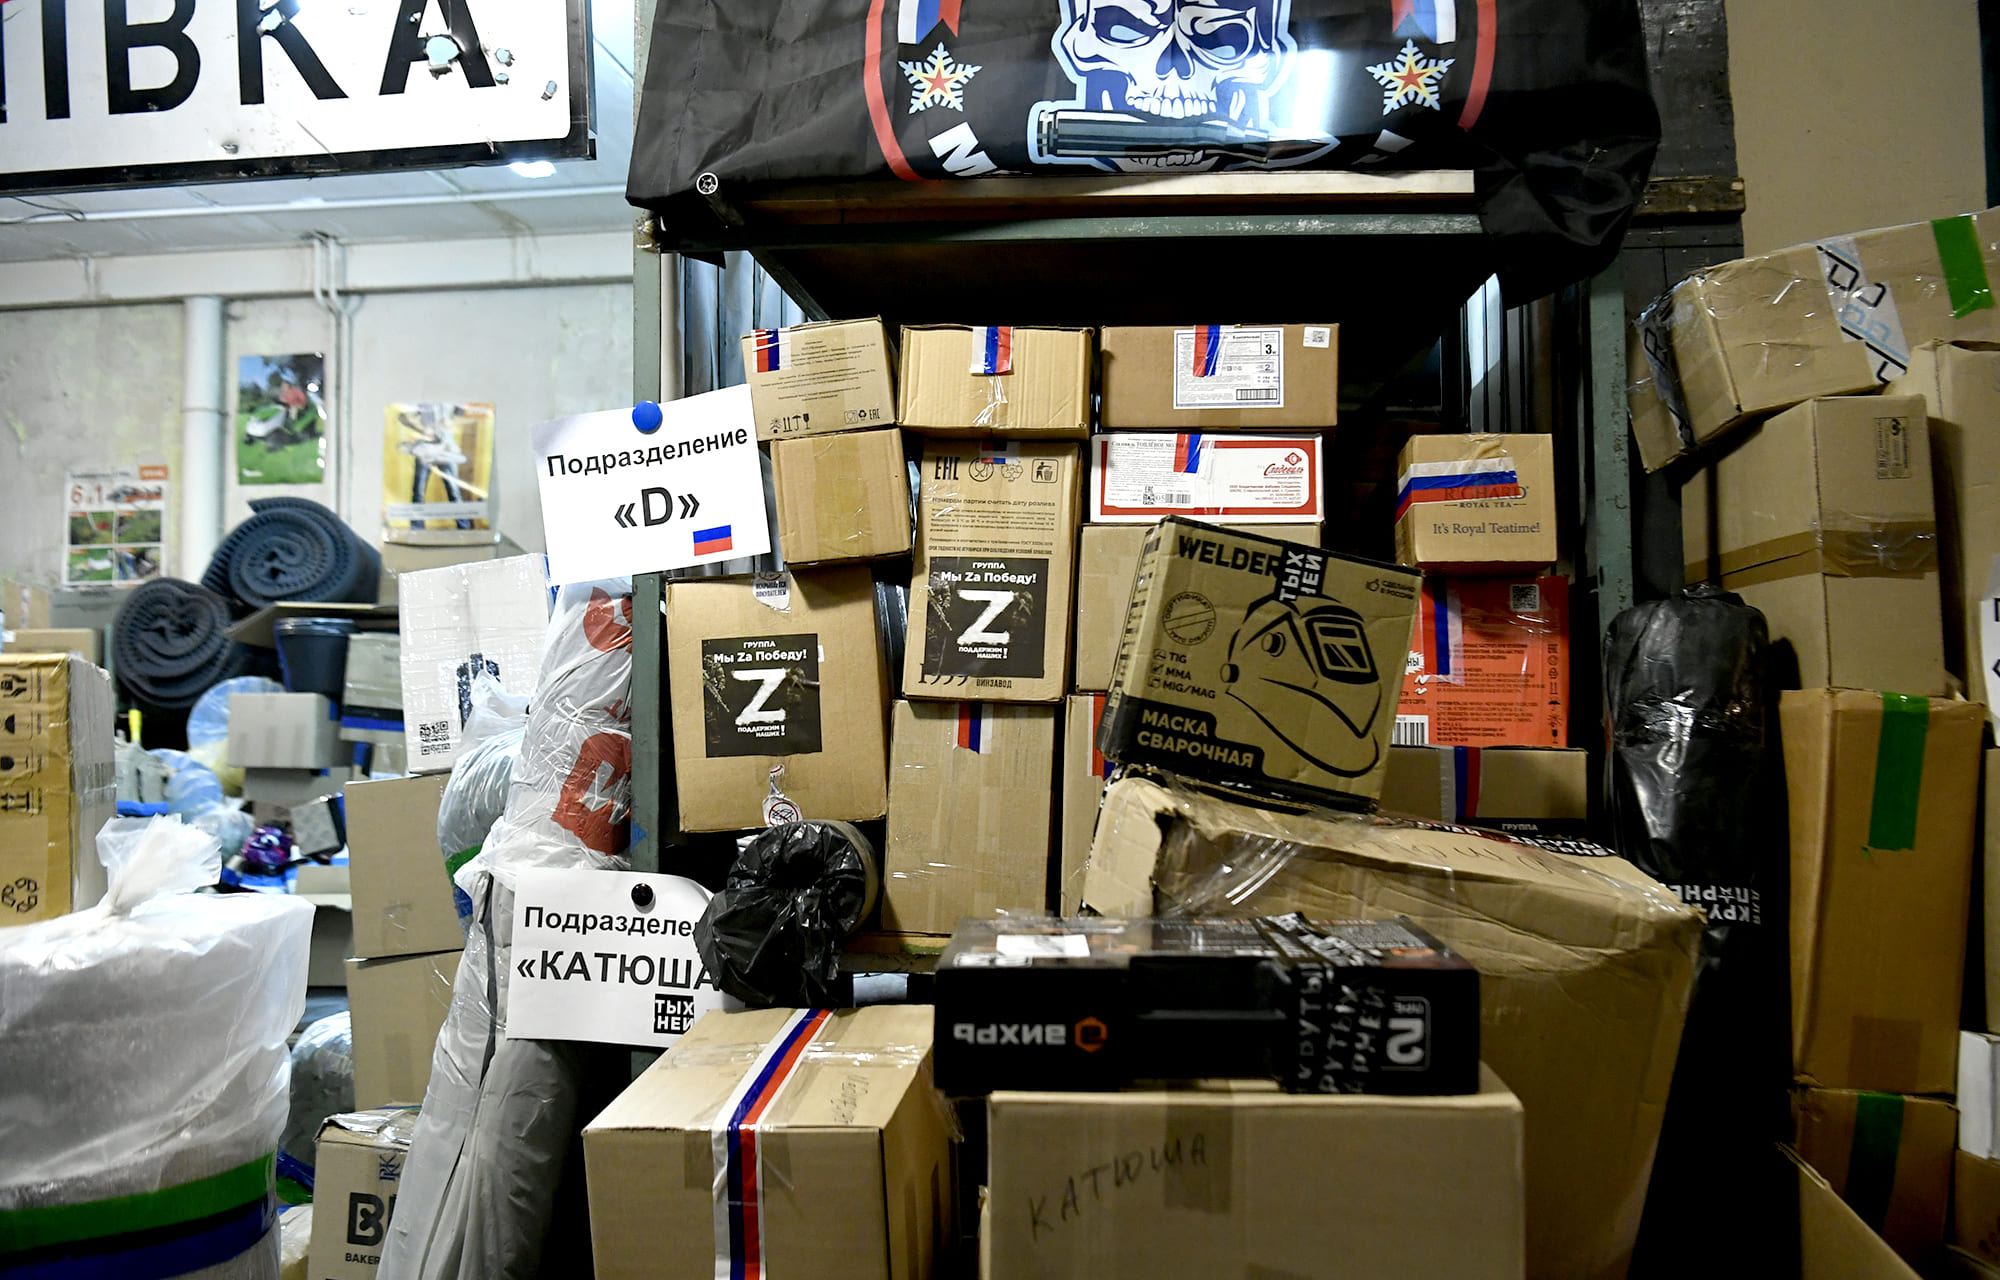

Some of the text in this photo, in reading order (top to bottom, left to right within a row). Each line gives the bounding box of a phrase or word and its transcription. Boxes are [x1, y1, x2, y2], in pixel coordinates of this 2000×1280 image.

[547, 428, 748, 477] Подразделение
[614, 486, 701, 532] «D»
[1433, 522, 1541, 537] It's Royal Teatime!
[972, 561, 1006, 570] ГРУППА
[941, 572, 1037, 585] Мы Za Победу!
[1279, 551, 1305, 601] ТЫХ
[956, 589, 1015, 645] Z
[743, 640, 776, 649] ГРУППА
[713, 648, 808, 663] Мы Za Победу!
[1169, 651, 1188, 664] TIG
[976, 678, 1013, 689] ВИНЗАВОД
[1165, 667, 1192, 681] MMA
[730, 667, 787, 726] Z
[1162, 681, 1216, 700] MIG/MAG
[1141, 709, 1209, 738] МАСКА
[1137, 731, 1255, 769] СВАРОЧНАЯ
[1501, 823, 1538, 832] ГРУППА
[525, 905, 697, 938] Подразделе
[1694, 903, 1750, 923] КРУ
[517, 949, 720, 992] «КАТЮША
[655, 999, 694, 1016] ТЫХ
[657, 1015, 693, 1031] НЕЙ
[953, 1022, 1067, 1047] ВИХРЬ
[1386, 1018, 1424, 1066] 2
[1026, 1132, 1208, 1241] КАТЮША
